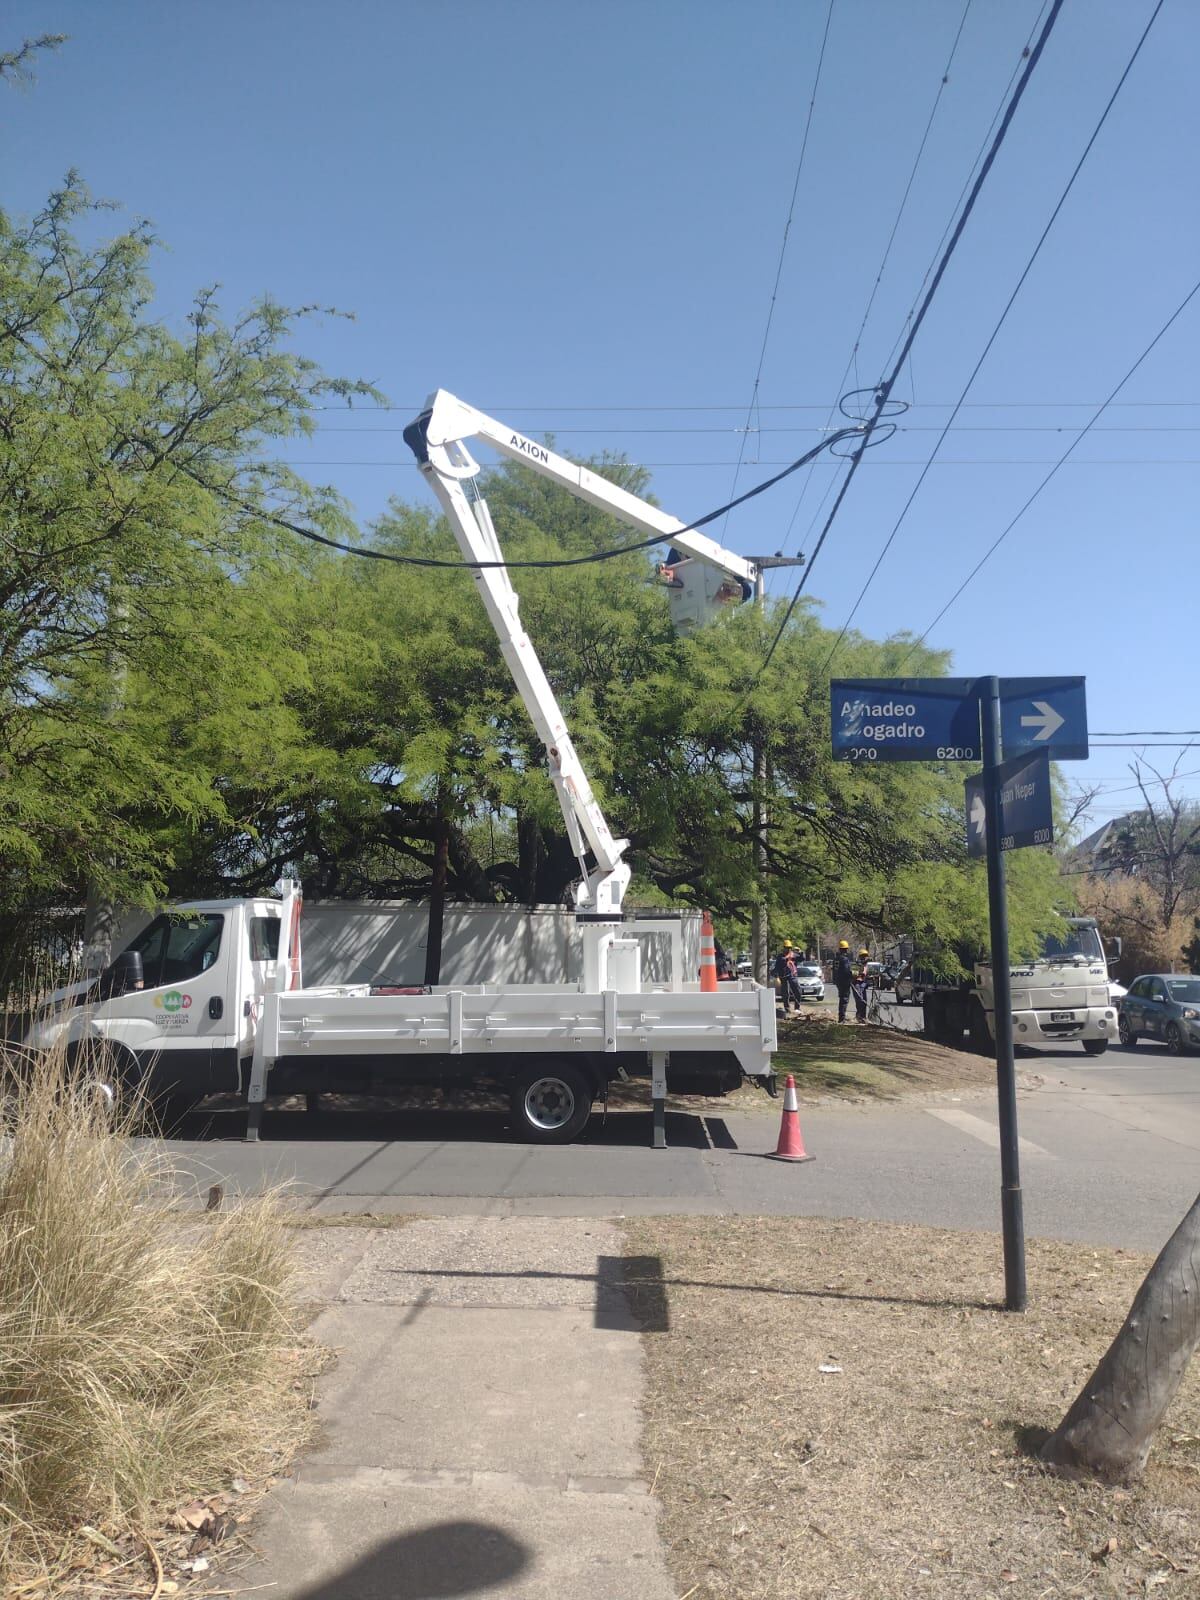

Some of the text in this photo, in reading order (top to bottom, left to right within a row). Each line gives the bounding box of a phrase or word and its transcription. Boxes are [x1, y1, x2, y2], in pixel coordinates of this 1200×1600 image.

[510, 435, 548, 463] AXION
[842, 722, 925, 741] ogadro
[936, 747, 974, 760] 6200
[1015, 782, 1036, 801] Neper
